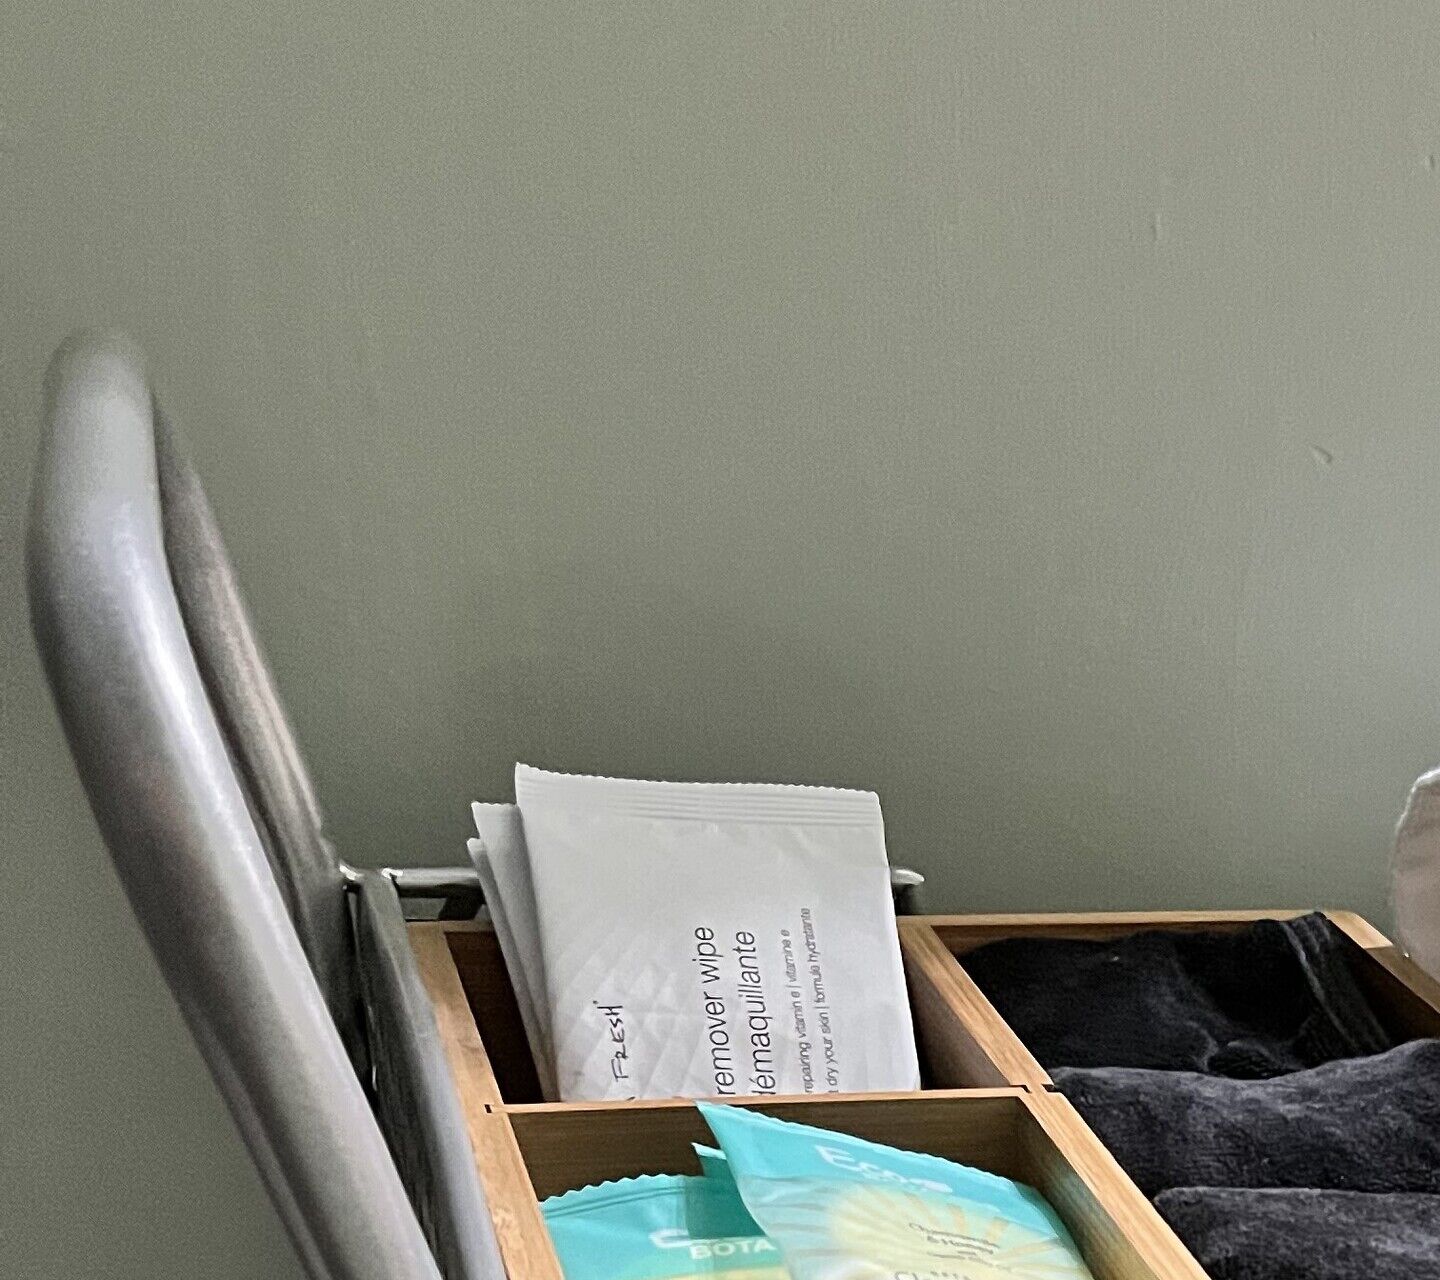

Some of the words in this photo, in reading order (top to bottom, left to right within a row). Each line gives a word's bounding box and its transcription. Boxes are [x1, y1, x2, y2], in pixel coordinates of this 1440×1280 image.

[692, 926, 724, 984] wipe
[792, 1000, 806, 1039] vitamin
[703, 991, 736, 1095] remover
[823, 1037, 838, 1065] your
[799, 1042, 814, 1093] repairing
[825, 1067, 839, 1086] dry
[689, 1238, 777, 1260] BOTA
